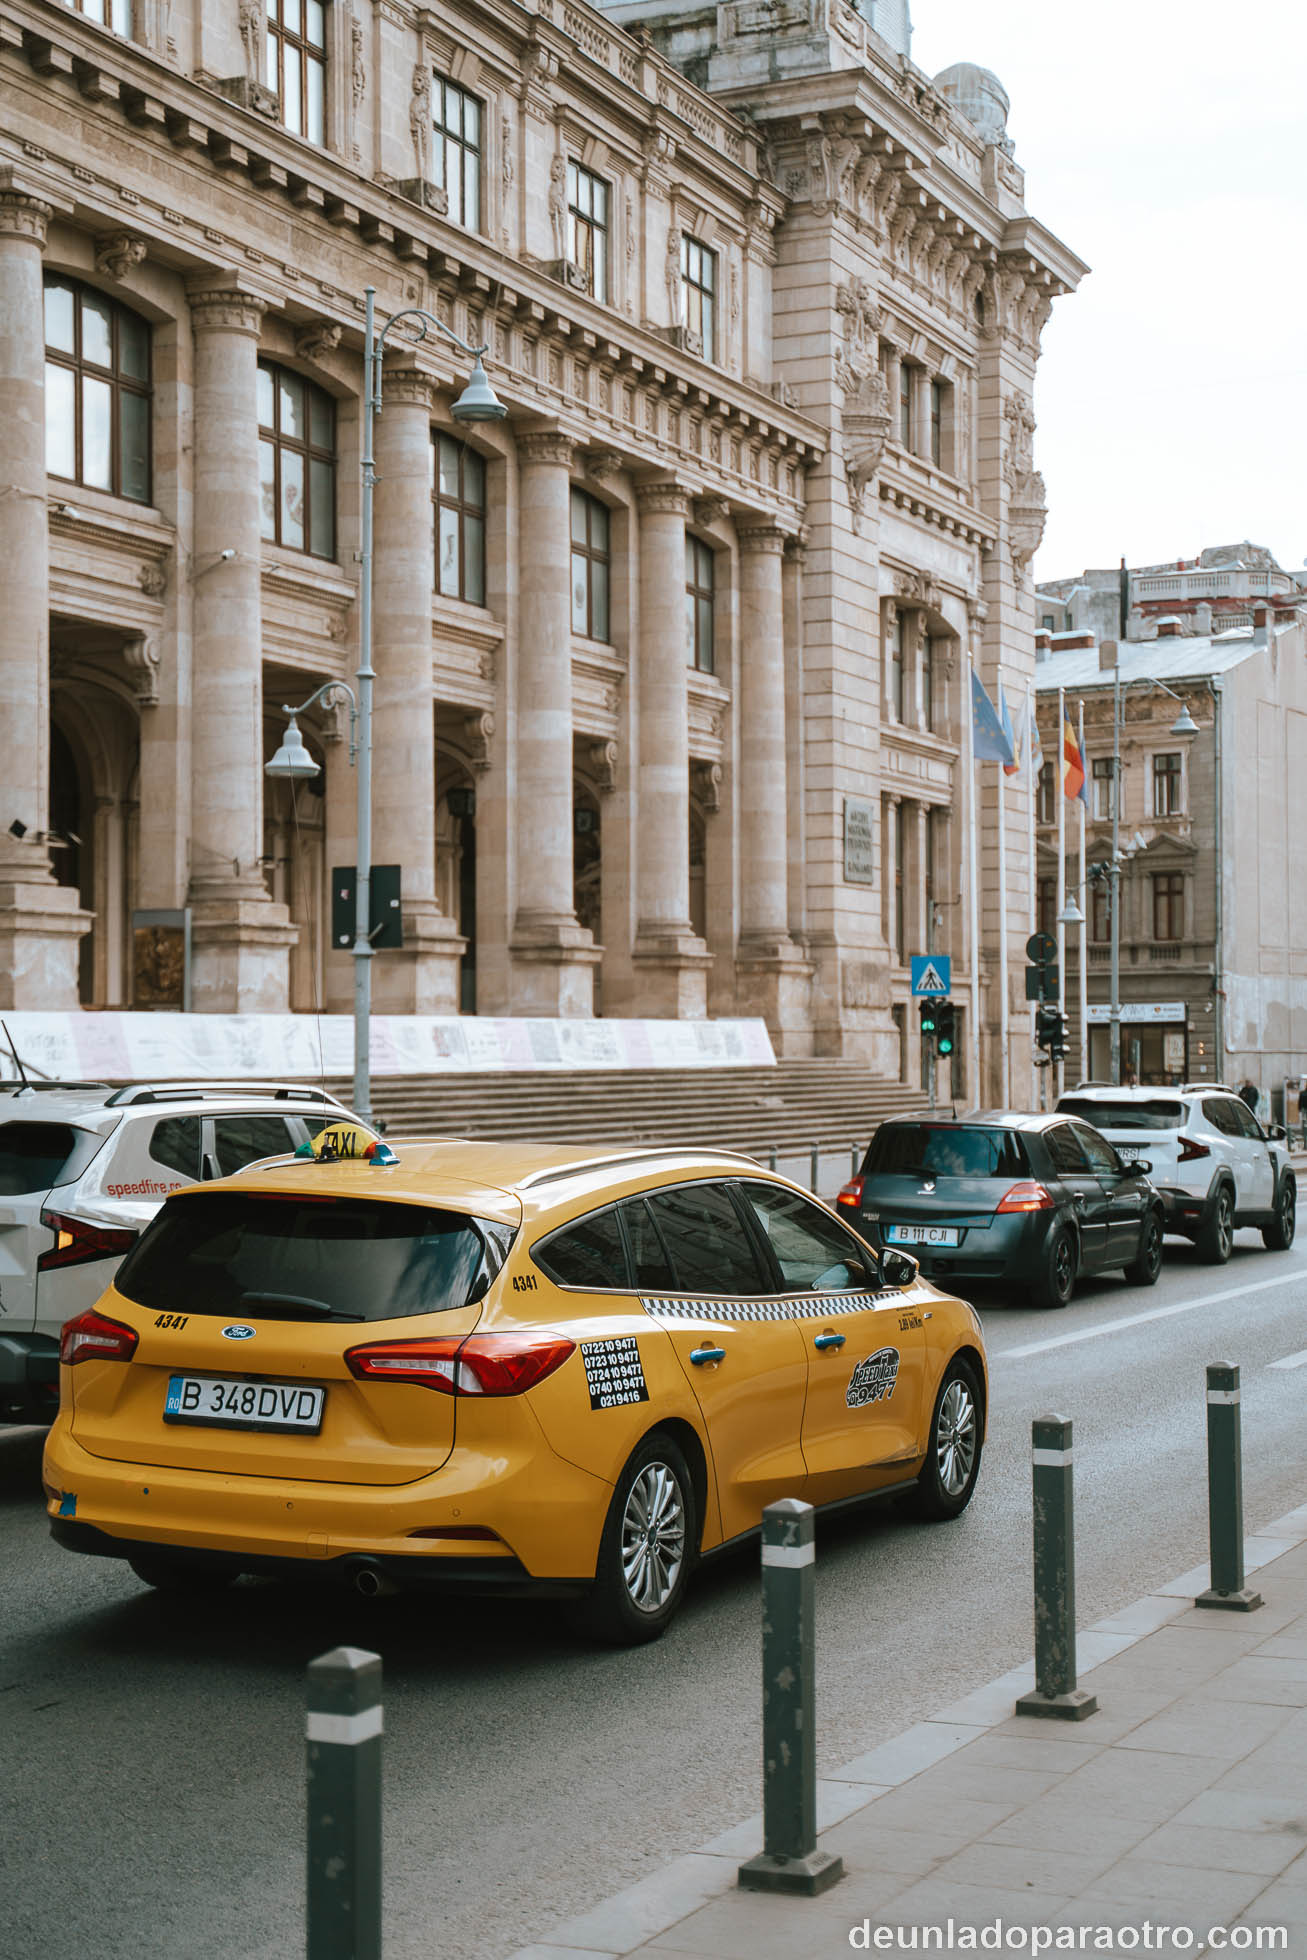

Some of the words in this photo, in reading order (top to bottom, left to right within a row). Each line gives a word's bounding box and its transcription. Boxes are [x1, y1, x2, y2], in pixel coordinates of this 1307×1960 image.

[325, 1132, 356, 1157] TAXI
[900, 1228, 908, 1239] B
[913, 1228, 925, 1240] 111
[512, 1275, 538, 1292] 4341
[154, 1314, 189, 1330] 4341
[581, 1342, 605, 1355] 0722
[615, 1337, 637, 1349] 9477
[584, 1356, 608, 1369] 0723
[608, 1354, 617, 1365] 10
[618, 1351, 639, 1363] 9477
[587, 1369, 611, 1382] 0724
[611, 1367, 620, 1378] 10
[621, 1364, 642, 1377] 9477
[589, 1382, 613, 1396] 0740
[613, 1380, 623, 1391] 10
[623, 1376, 644, 1390] 9477
[168, 1397, 179, 1409] RO
[182, 1382, 201, 1410] B
